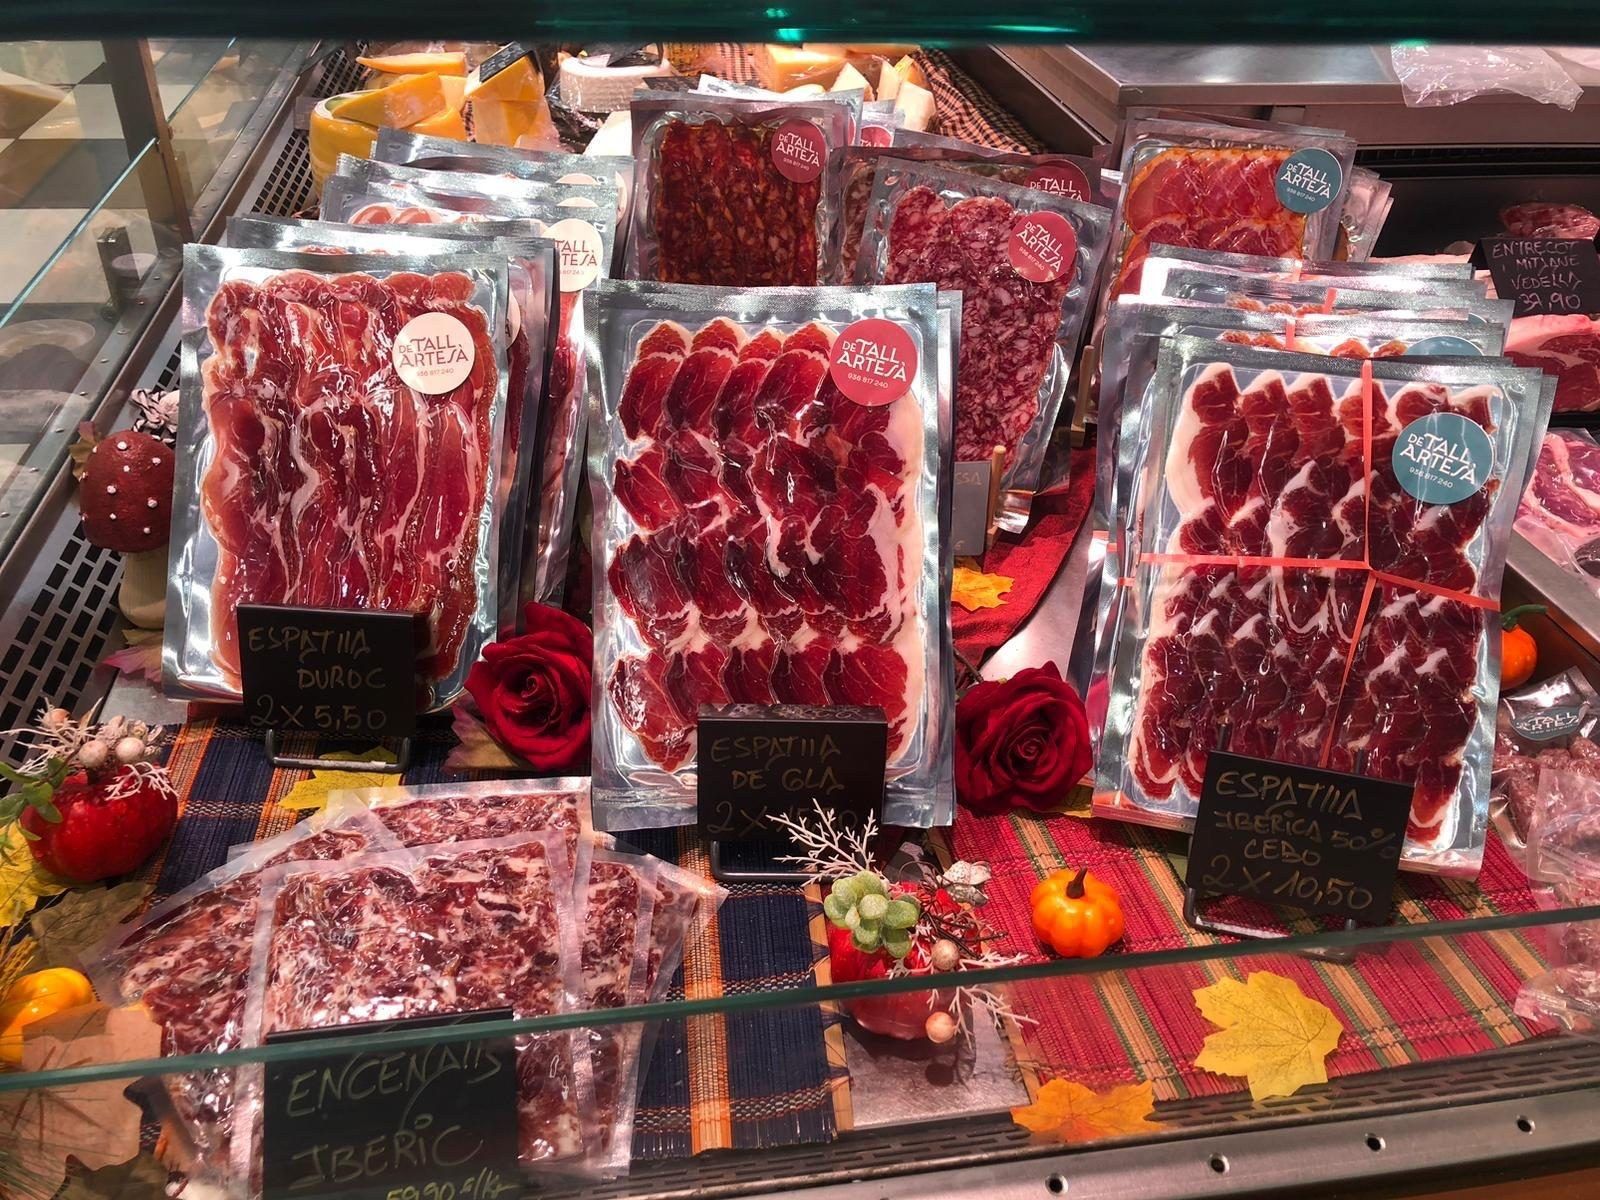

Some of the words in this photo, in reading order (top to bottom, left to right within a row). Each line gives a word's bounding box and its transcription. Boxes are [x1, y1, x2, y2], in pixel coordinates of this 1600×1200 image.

[776, 141, 820, 167] ARTESÀ
[788, 132, 815, 153] TALL
[1040, 177, 1076, 192] TALL
[1280, 171, 1331, 199] ARTESÀ
[1286, 163, 1298, 173] DE
[1298, 162, 1327, 185] TALL
[1016, 229, 1063, 273] ARTESÀ
[1025, 221, 1036, 233] DE
[1035, 224, 1062, 257] TALL
[1492, 240, 1579, 258] ENTRECOT
[561, 248, 598, 266] TESÀ
[1511, 271, 1582, 290] VEDELLA
[398, 344, 413, 354] DE
[410, 334, 456, 352] TALL
[399, 344, 469, 368] ARTESÀ
[842, 340, 857, 352] DE
[856, 338, 899, 364] TALL
[836, 351, 906, 382] ARTESÀ
[873, 381, 888, 389] 240
[1408, 433, 1424, 447] DE
[1424, 432, 1471, 465] TALL
[1400, 444, 1477, 485] ARTESÀ
[1437, 477, 1453, 488] 240
[296, 665, 387, 690] DUROC
[314, 704, 387, 731] 5,50
[731, 768, 767, 790] DE
[782, 765, 845, 795] GLA
[1273, 870, 1373, 909] 10,50
